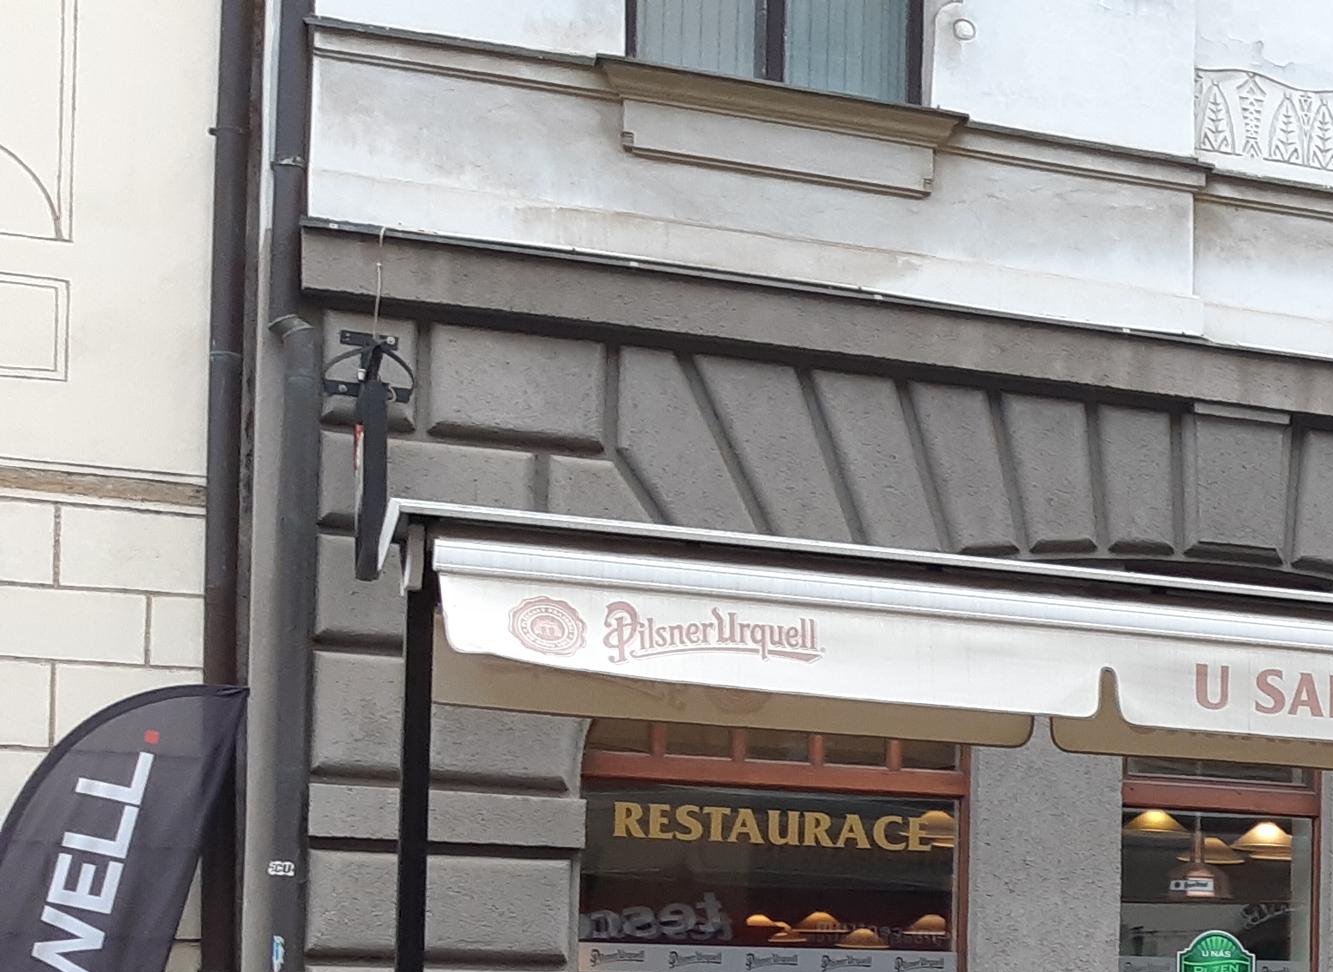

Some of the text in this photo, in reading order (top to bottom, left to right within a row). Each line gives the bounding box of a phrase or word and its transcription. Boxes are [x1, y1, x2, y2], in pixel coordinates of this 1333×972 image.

[603, 601, 713, 664] Pilsner
[712, 607, 818, 662] Urquell
[1195, 663, 1230, 711] U
[612, 800, 933, 851] RESTAURACE
[1211, 949, 1232, 958] NÁS
